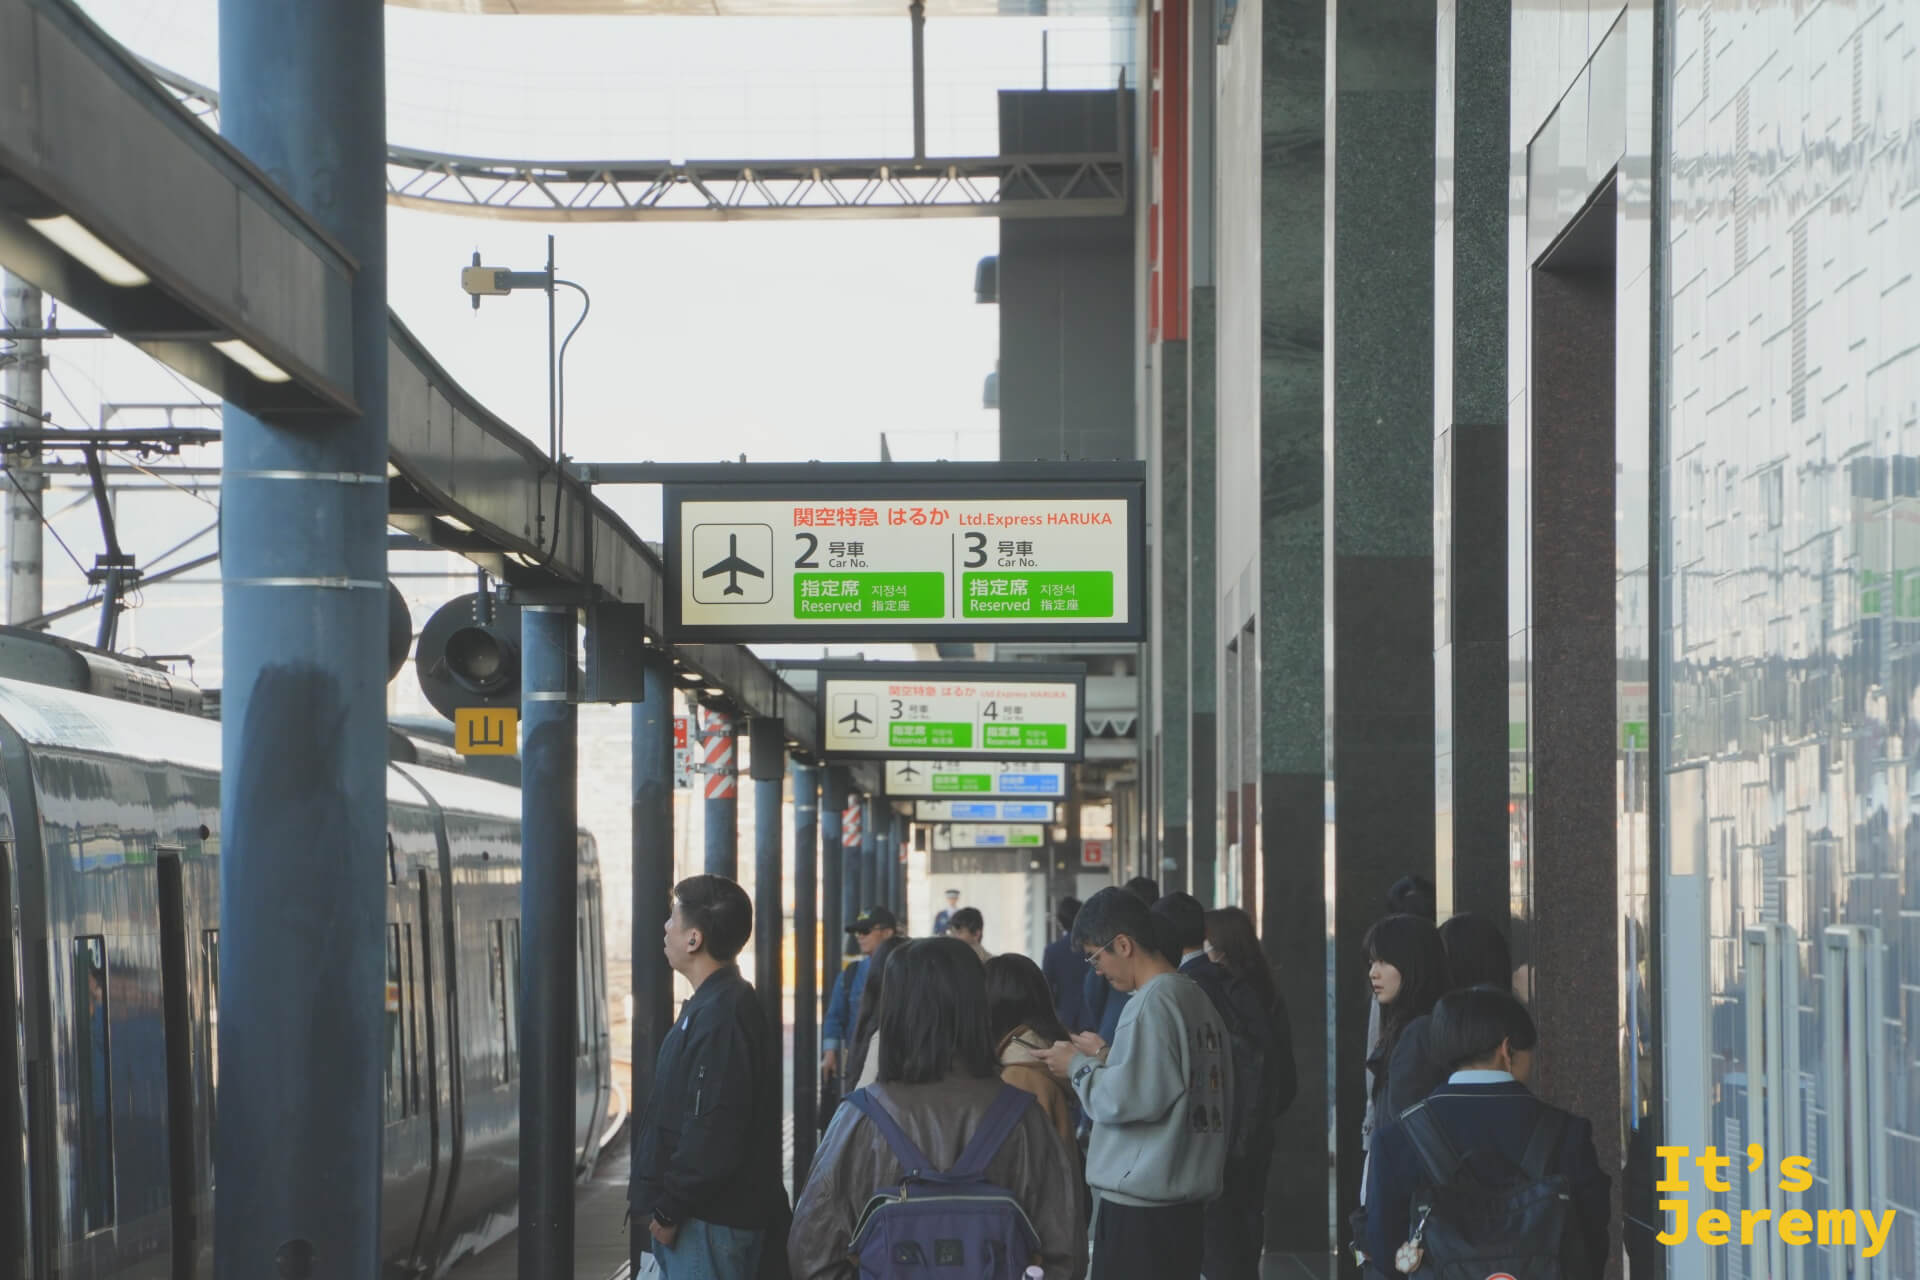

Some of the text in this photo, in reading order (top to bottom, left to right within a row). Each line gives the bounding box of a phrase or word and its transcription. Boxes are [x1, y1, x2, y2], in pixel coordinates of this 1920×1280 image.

[793, 508, 1113, 528] 関空特急 はるか Ltd.Express HARUKA
[795, 532, 865, 568] 2 号車
[963, 531, 1034, 568] 3 号車
[828, 558, 869, 568] Car No.
[997, 557, 1038, 567] Car No.
[801, 579, 908, 597] 指定席 지정석
[969, 579, 1076, 597] 指定席 지정석
[801, 600, 862, 612] Reserved
[970, 599, 1031, 611] Reserved
[889, 699, 903, 719] 3
[983, 700, 998, 720] 4
[469, 715, 504, 747] 山
